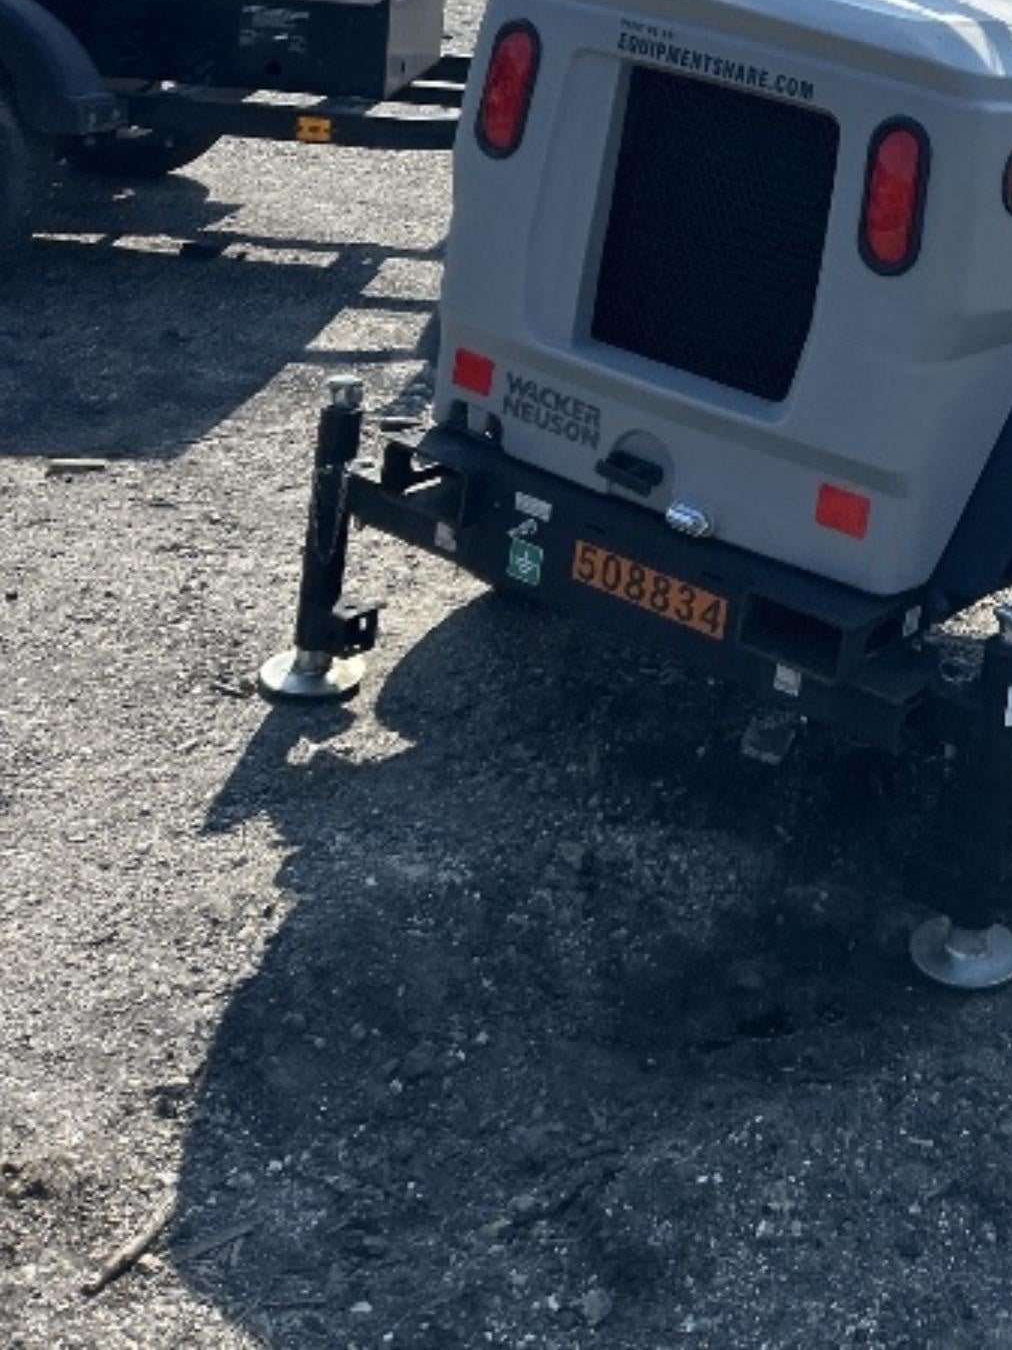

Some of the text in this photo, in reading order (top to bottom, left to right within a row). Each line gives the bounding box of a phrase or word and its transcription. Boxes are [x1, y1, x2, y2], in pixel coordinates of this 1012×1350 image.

[617, 32, 815, 99] EQUIPMENTSHARE.COM
[503, 394, 600, 451] NEUSON
[506, 371, 601, 428] WACKER
[578, 546, 722, 633] 508834
